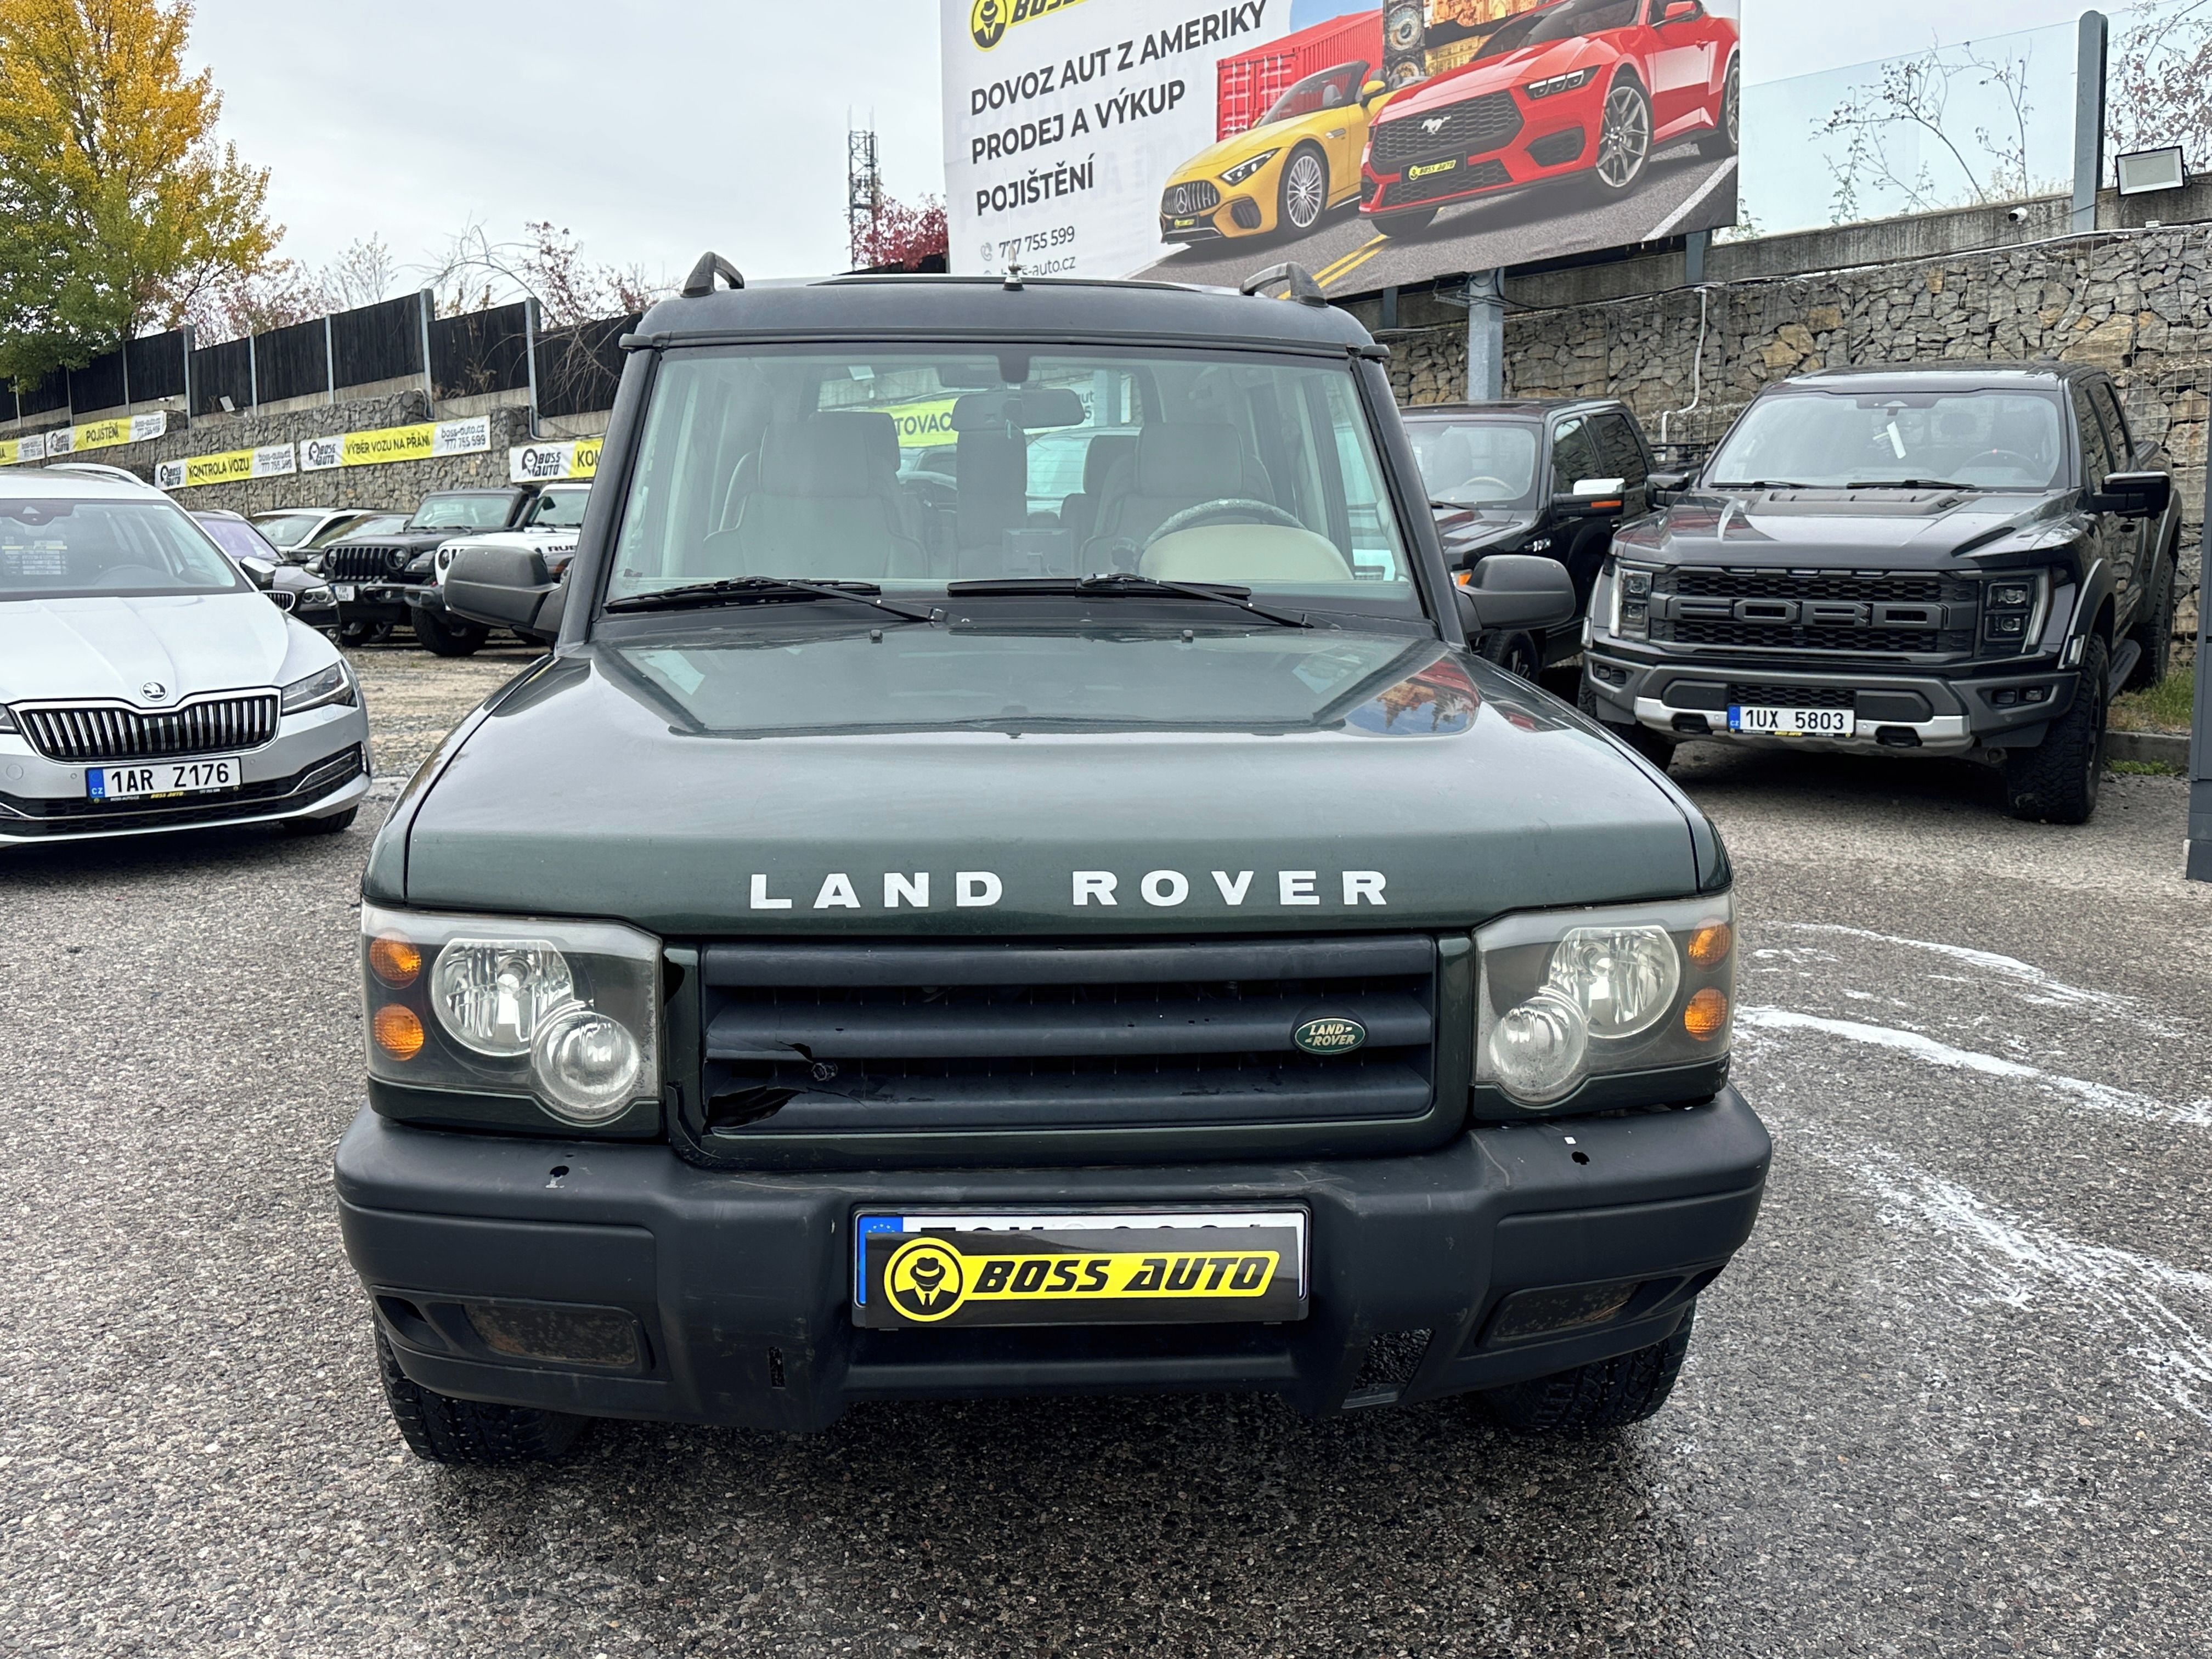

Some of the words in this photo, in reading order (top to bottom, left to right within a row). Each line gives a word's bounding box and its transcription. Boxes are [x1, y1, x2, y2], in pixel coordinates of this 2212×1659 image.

[971, 65, 1054, 115] DOVOZ
[1060, 48, 1111, 88] AUT
[1118, 40, 1133, 72] Z
[1139, 0, 1267, 65] AMERIKY
[972, 114, 1064, 165] PRODEJ
[1071, 108, 1090, 137] A
[1095, 80, 1185, 128] VÝKUP
[977, 153, 1094, 216] POJIŠTĚNÍ
[1025, 232, 1047, 252] 755
[1051, 225, 1075, 246] 599
[441, 425, 485, 438] boss-auto.cz
[472, 434, 486, 446] 599
[319, 444, 336, 455] BOSS
[346, 441, 370, 455] VÝBĚR
[371, 438, 392, 452] VOZU
[393, 437, 405, 450] NA
[406, 434, 431, 448] PŘÁNÍ
[189, 463, 227, 478] KONTROLA
[228, 457, 250, 472] VOZU
[538, 452, 561, 465] BOSS
[534, 464, 560, 477] AUTO
[1746, 710, 1778, 729] 1UX
[1795, 712, 1844, 730] 5803
[111, 769, 154, 793] 1AR
[172, 763, 229, 788] Z176
[749, 871, 1003, 910] LAND
[1072, 869, 1387, 906] ROVER
[1310, 1024, 1345, 1036] LAND
[1312, 1034, 1356, 1046] ROVER
[972, 1259, 1112, 1293] BOSS
[1121, 1256, 1270, 1291] AUTO
